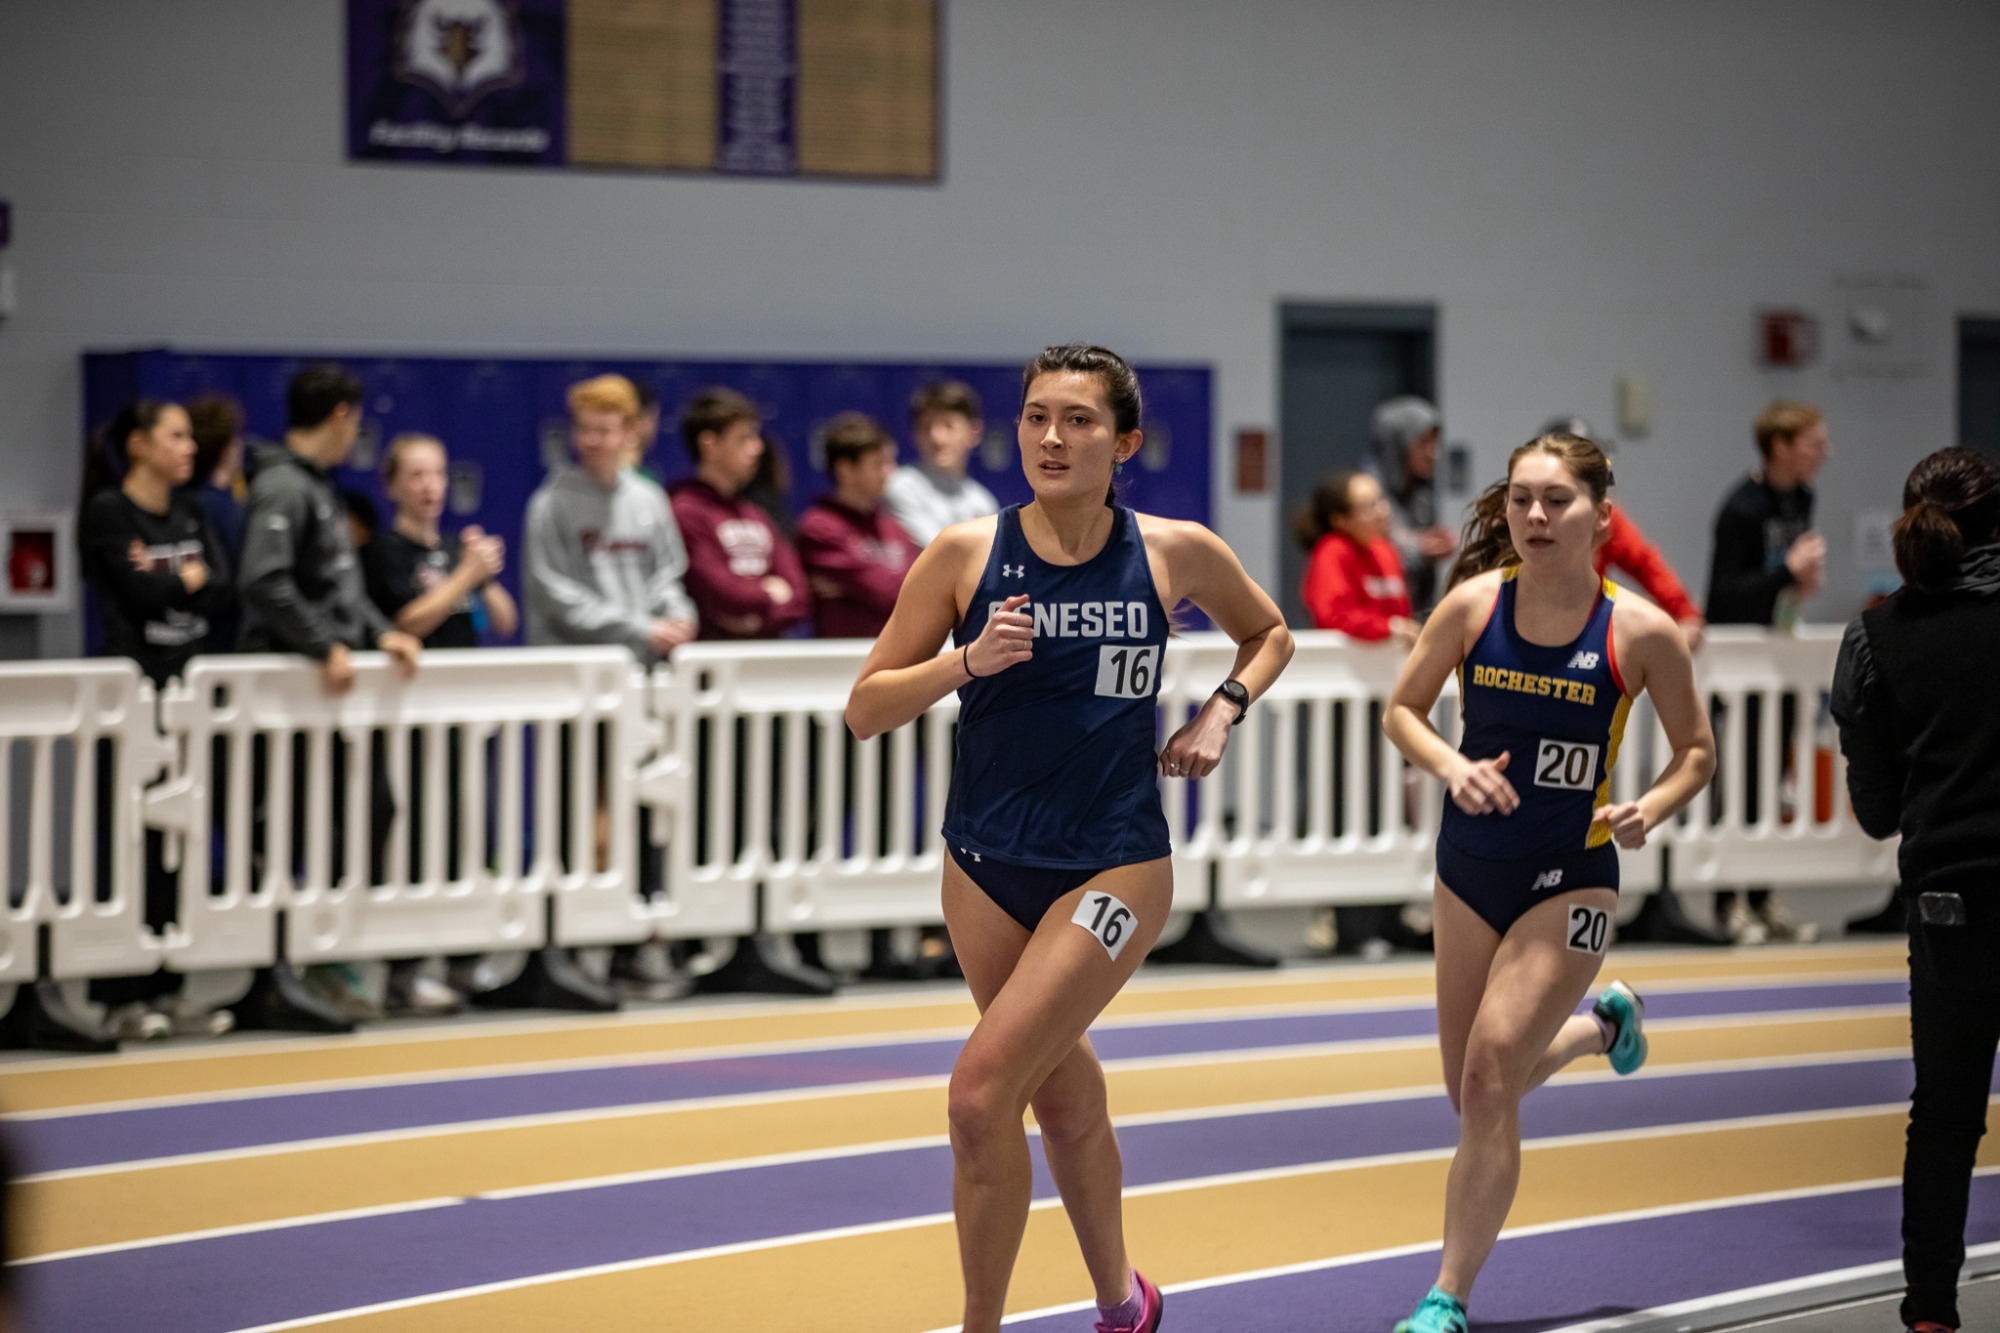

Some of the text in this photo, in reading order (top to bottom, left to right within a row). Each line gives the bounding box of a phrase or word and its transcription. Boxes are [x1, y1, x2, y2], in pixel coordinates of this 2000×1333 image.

[1110, 649, 1151, 695] 16
[1473, 665, 1596, 705] ROCHESTER
[1538, 743, 1589, 785] 20
[1089, 895, 1130, 948] 16
[1570, 907, 1607, 952] 20
